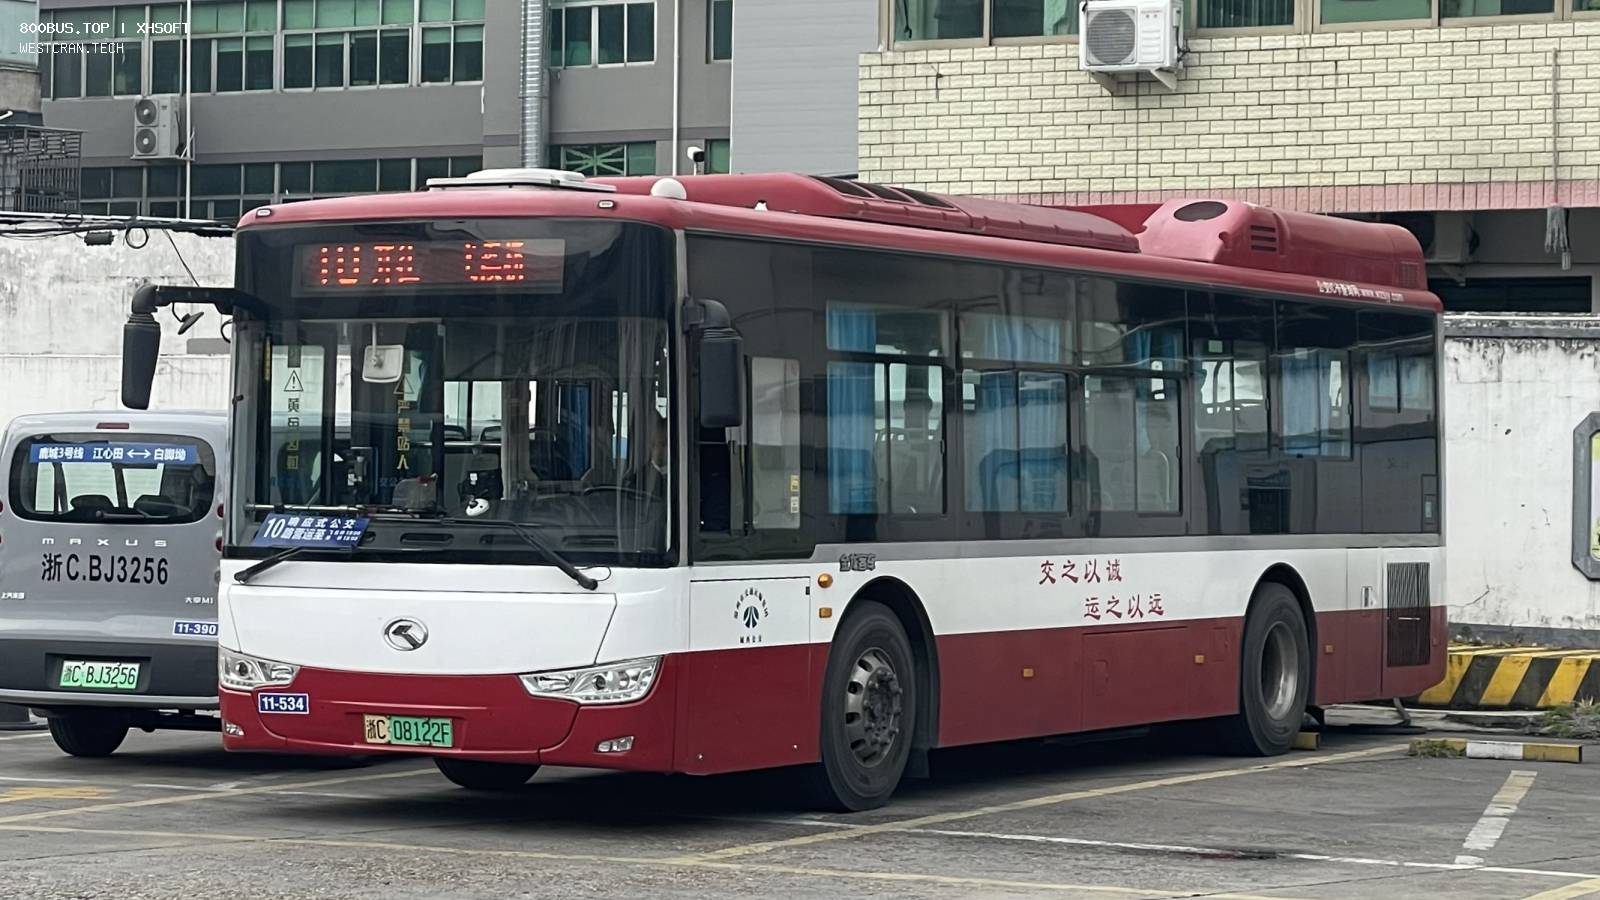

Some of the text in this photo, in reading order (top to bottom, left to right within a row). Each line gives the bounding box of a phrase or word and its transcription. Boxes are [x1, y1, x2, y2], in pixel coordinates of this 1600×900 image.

[92, 447, 124, 460] 江心田
[263, 517, 288, 539] 10
[42, 537, 168, 548] MAXUS
[1039, 558, 1122, 585] 交之以诚
[1083, 593, 1165, 621] 运之以远
[176, 623, 217, 635] 11-390
[262, 696, 305, 711] 11-534
